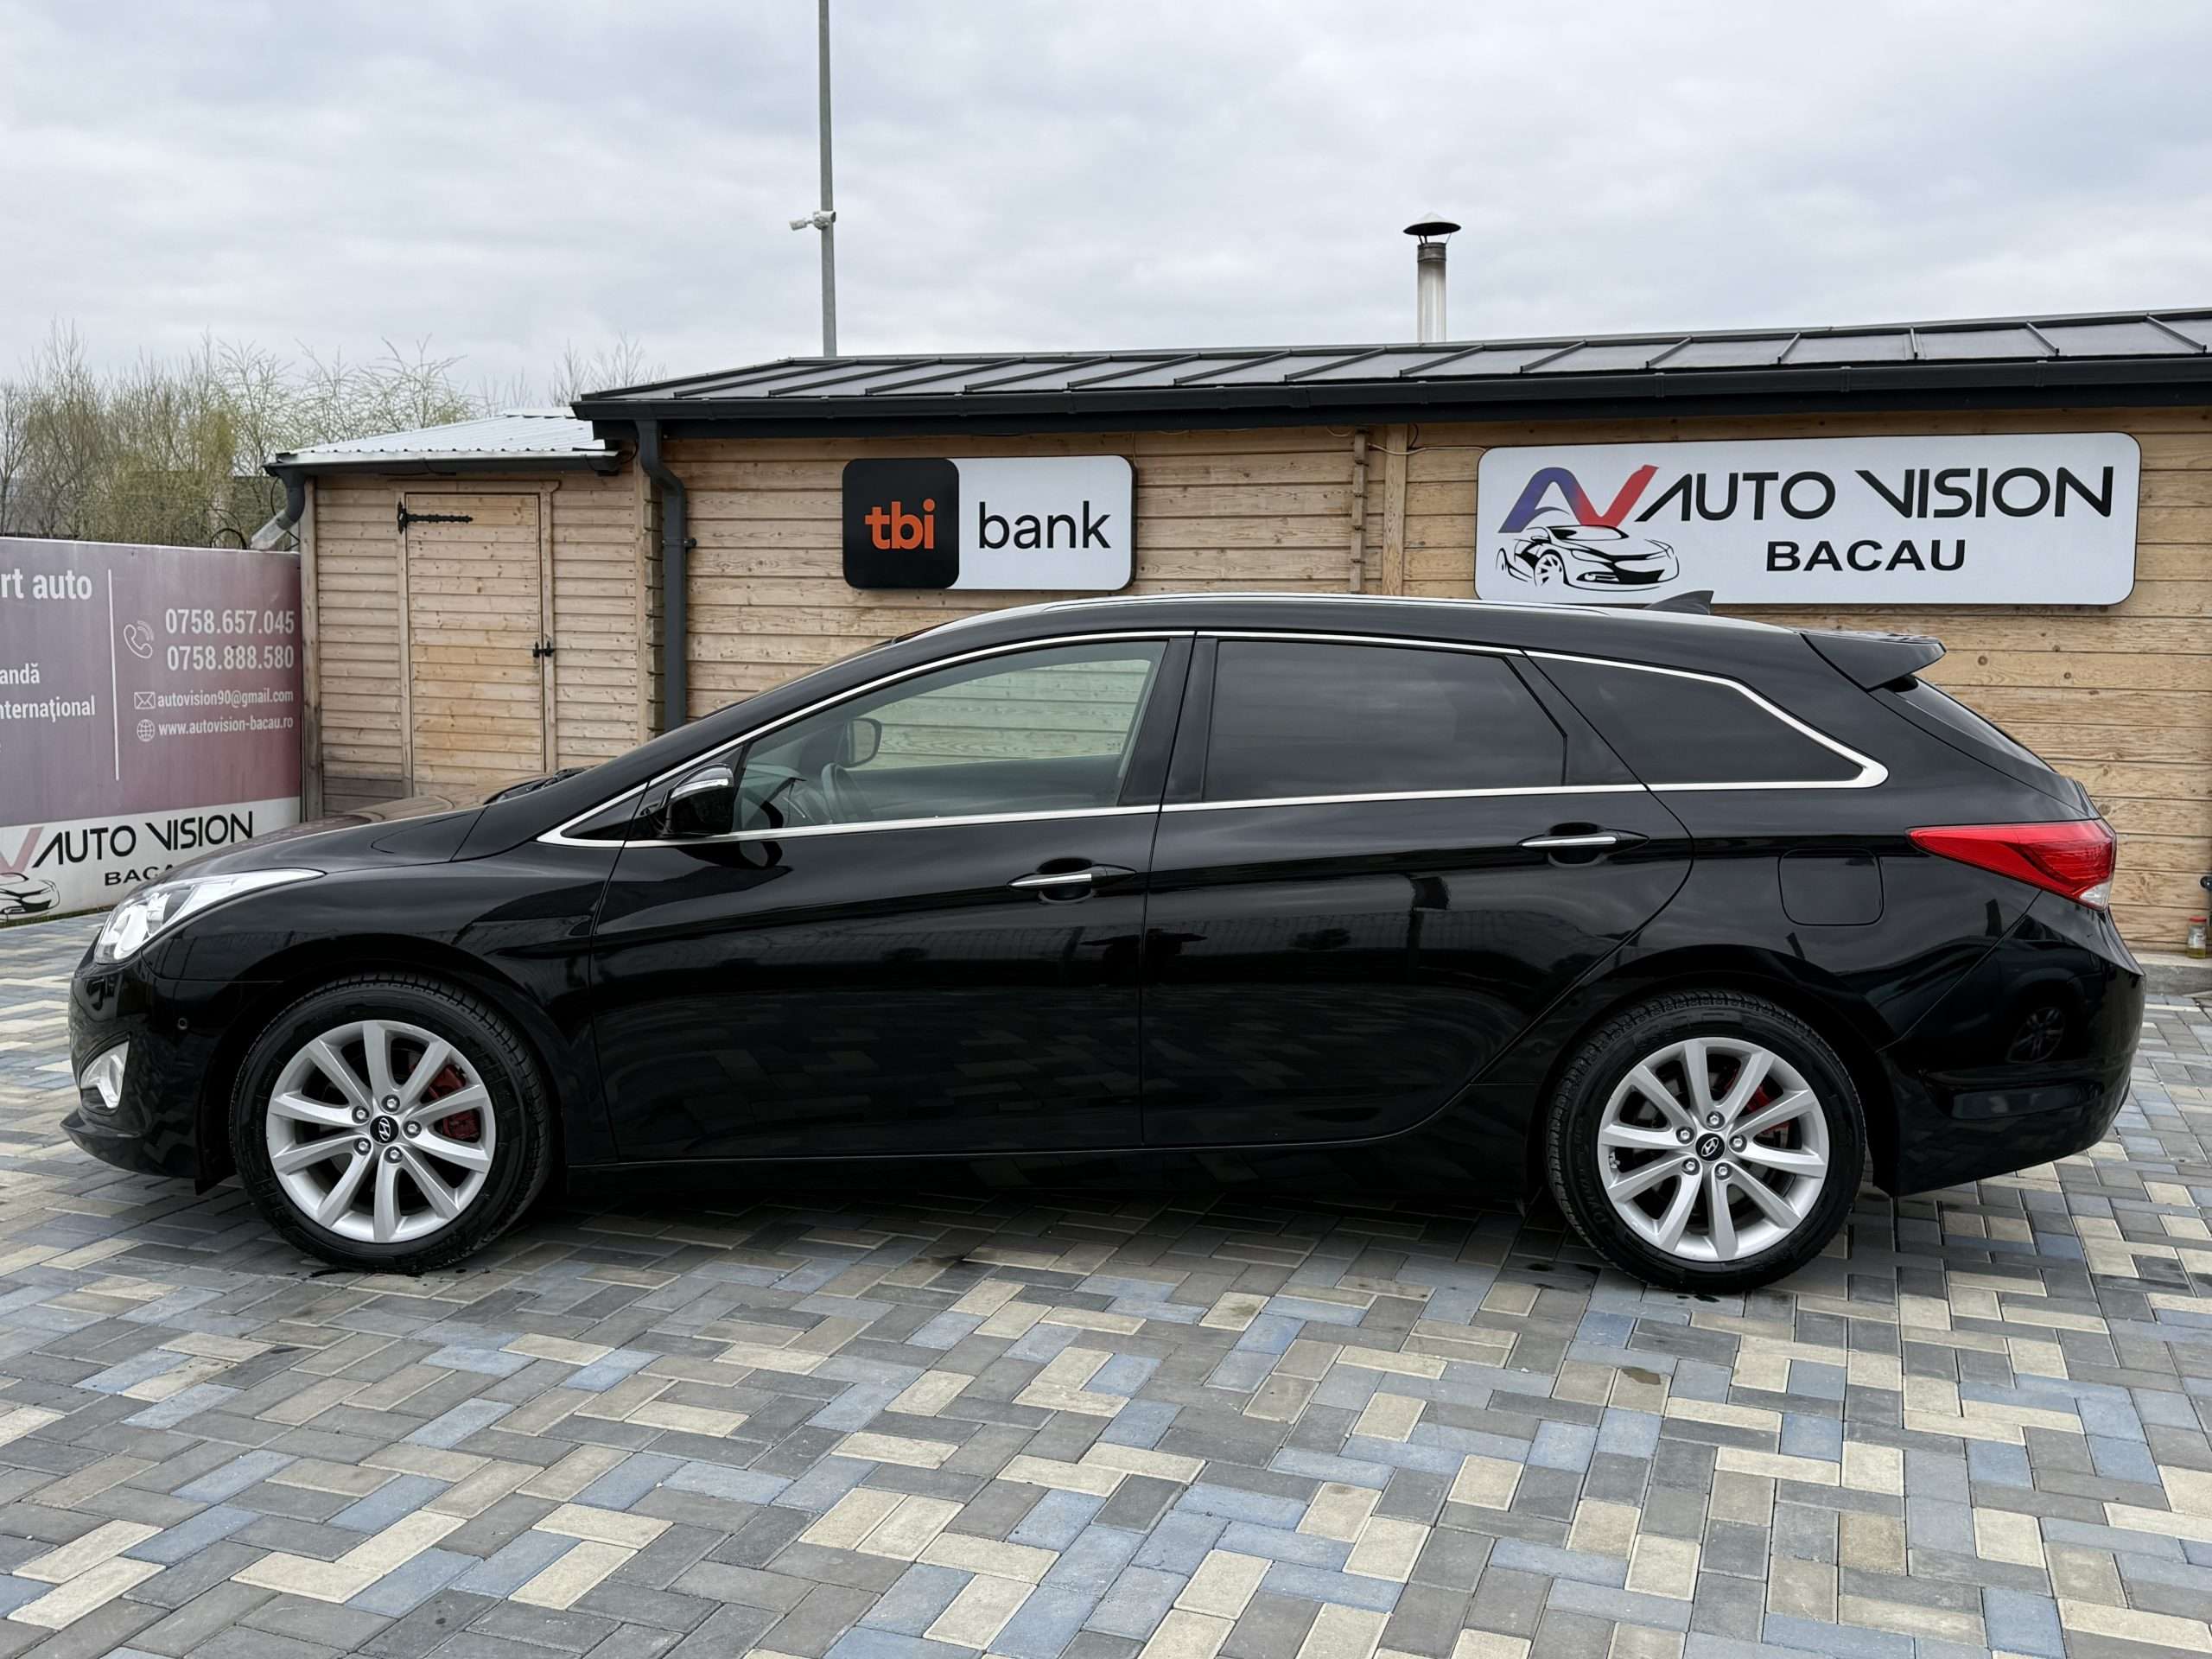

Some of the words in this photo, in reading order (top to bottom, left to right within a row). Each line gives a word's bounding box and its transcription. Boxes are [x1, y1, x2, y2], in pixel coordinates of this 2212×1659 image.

[1634, 471, 1836, 522] AUTO
[1854, 466, 2114, 518] VISION
[865, 499, 935, 550] tbi
[978, 500, 1112, 550] bank
[1766, 539, 1966, 572] BACAU
[0, 568, 24, 599] rt
[33, 569, 92, 600] auto
[165, 608, 295, 634] 0758.657.045
[167, 645, 295, 671] 0758.888.580
[157, 687, 294, 709] autovision90@gmail.com
[158, 715, 294, 735] www.autovision-bacau.ro
[32, 825, 137, 868] AUTO
[145, 810, 253, 851] VISION
